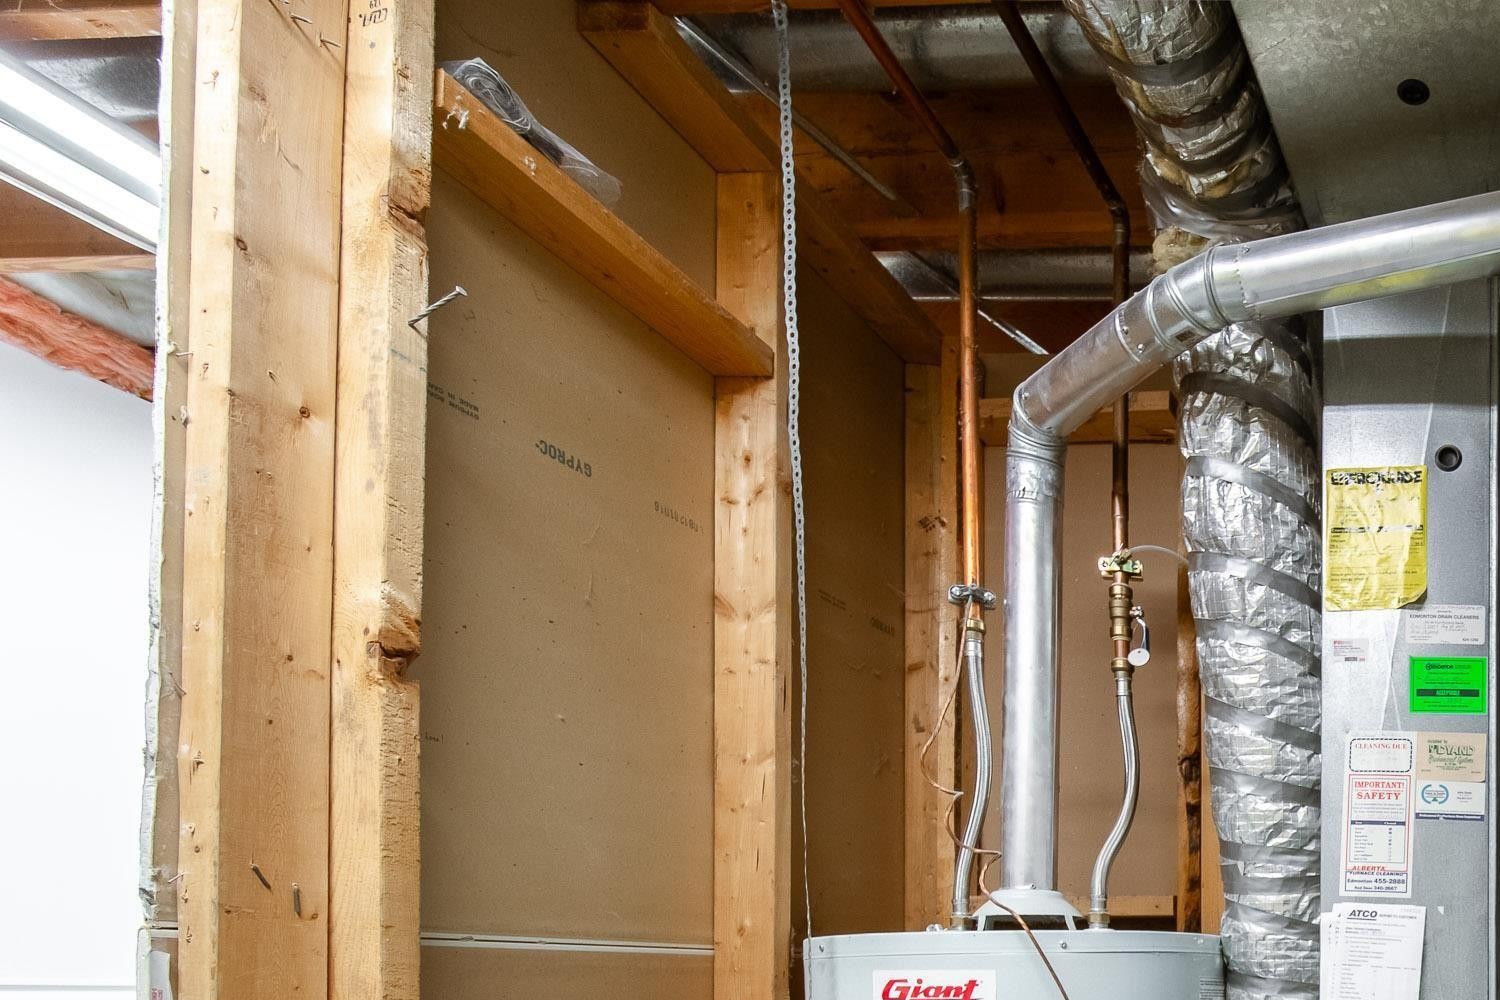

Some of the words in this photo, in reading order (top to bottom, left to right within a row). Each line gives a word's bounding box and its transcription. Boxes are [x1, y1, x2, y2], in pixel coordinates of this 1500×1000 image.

[538, 439, 592, 478] GYPROC
[1356, 792, 1400, 800] SAFETY
[1349, 910, 1378, 918] ATCO
